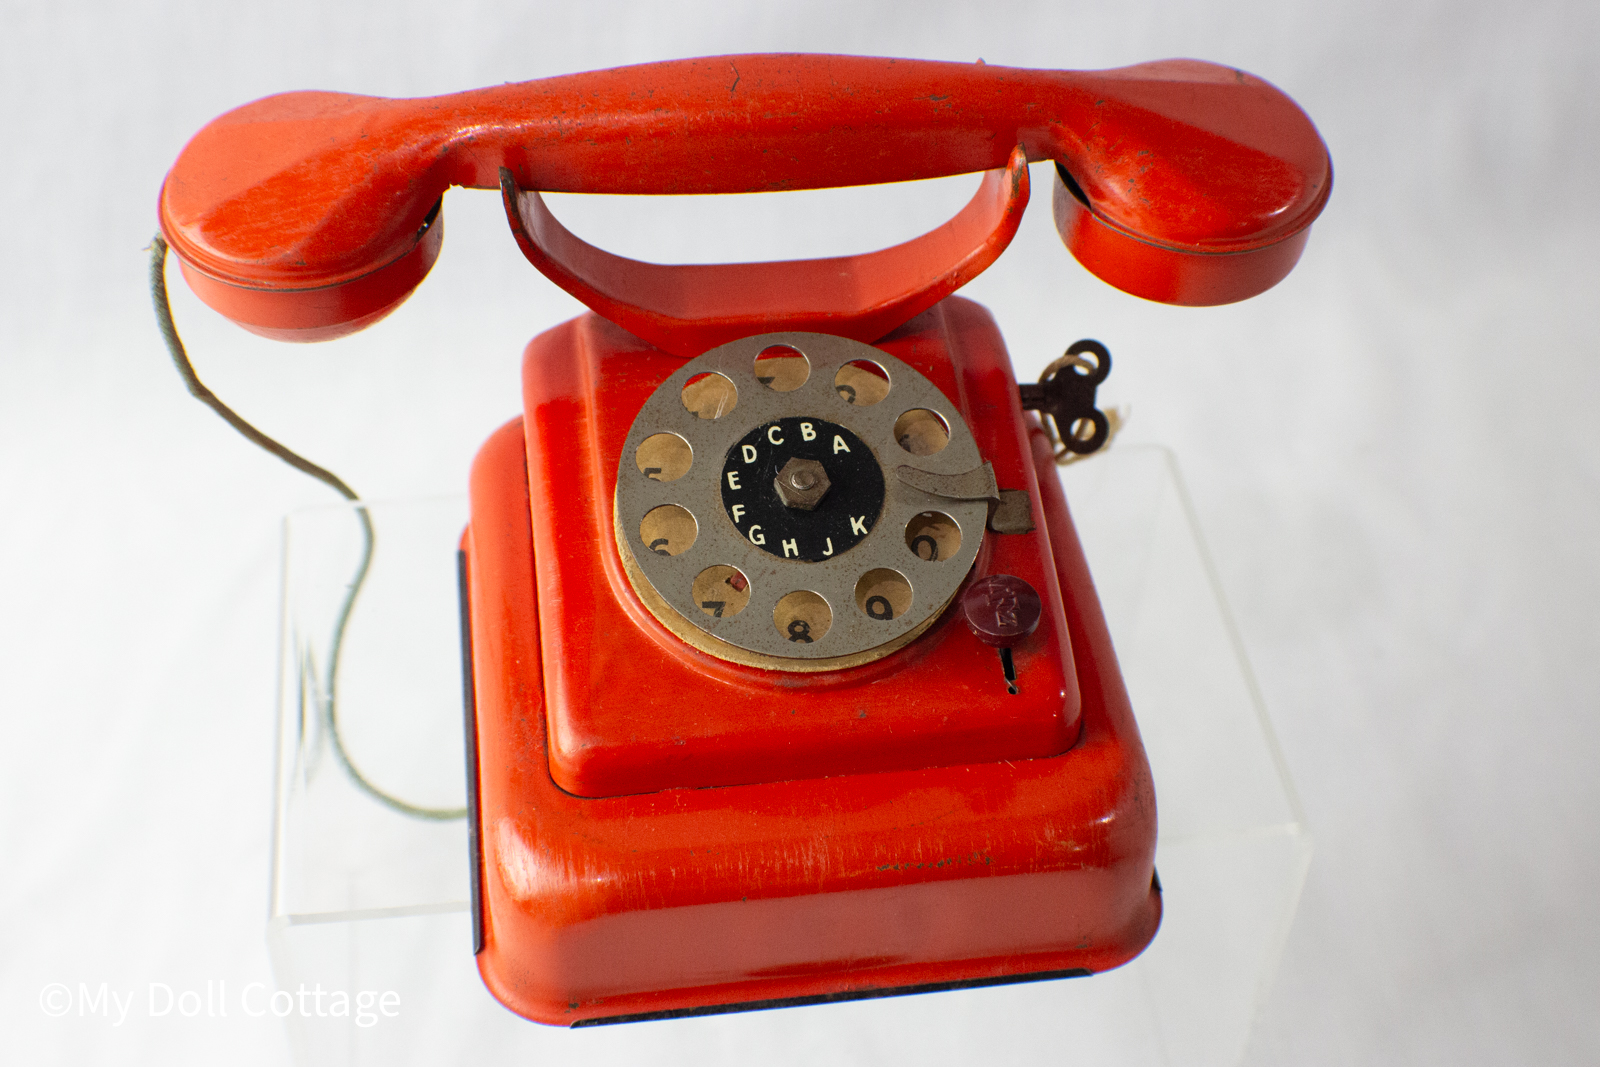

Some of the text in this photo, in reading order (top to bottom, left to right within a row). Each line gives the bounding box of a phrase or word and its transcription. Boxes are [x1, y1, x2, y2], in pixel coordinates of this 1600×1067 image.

[727, 422, 868, 558] A B C D E F G H J K
